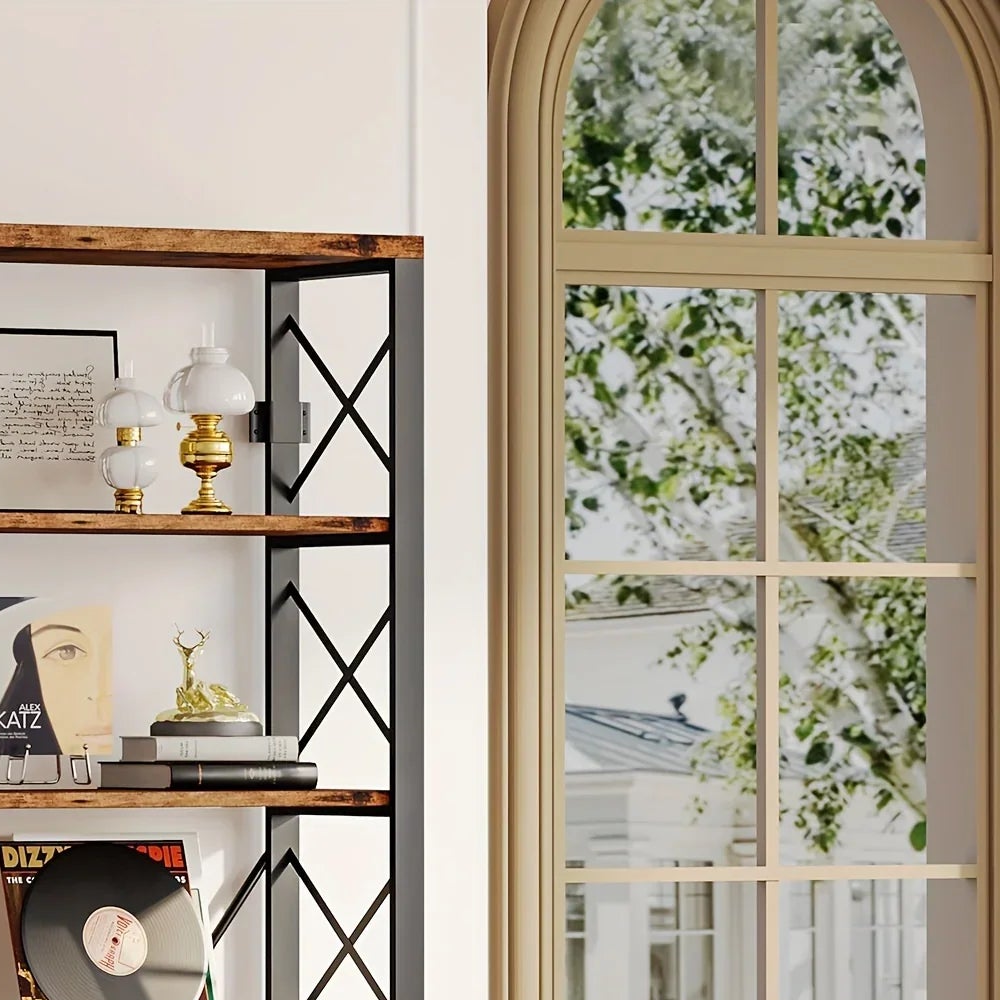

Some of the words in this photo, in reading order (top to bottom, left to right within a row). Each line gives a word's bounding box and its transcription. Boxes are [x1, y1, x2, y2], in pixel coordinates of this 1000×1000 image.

[18, 703, 41, 711] ALEX
[1, 845, 72, 868] DIZZ
[6, 876, 24, 884] THE
